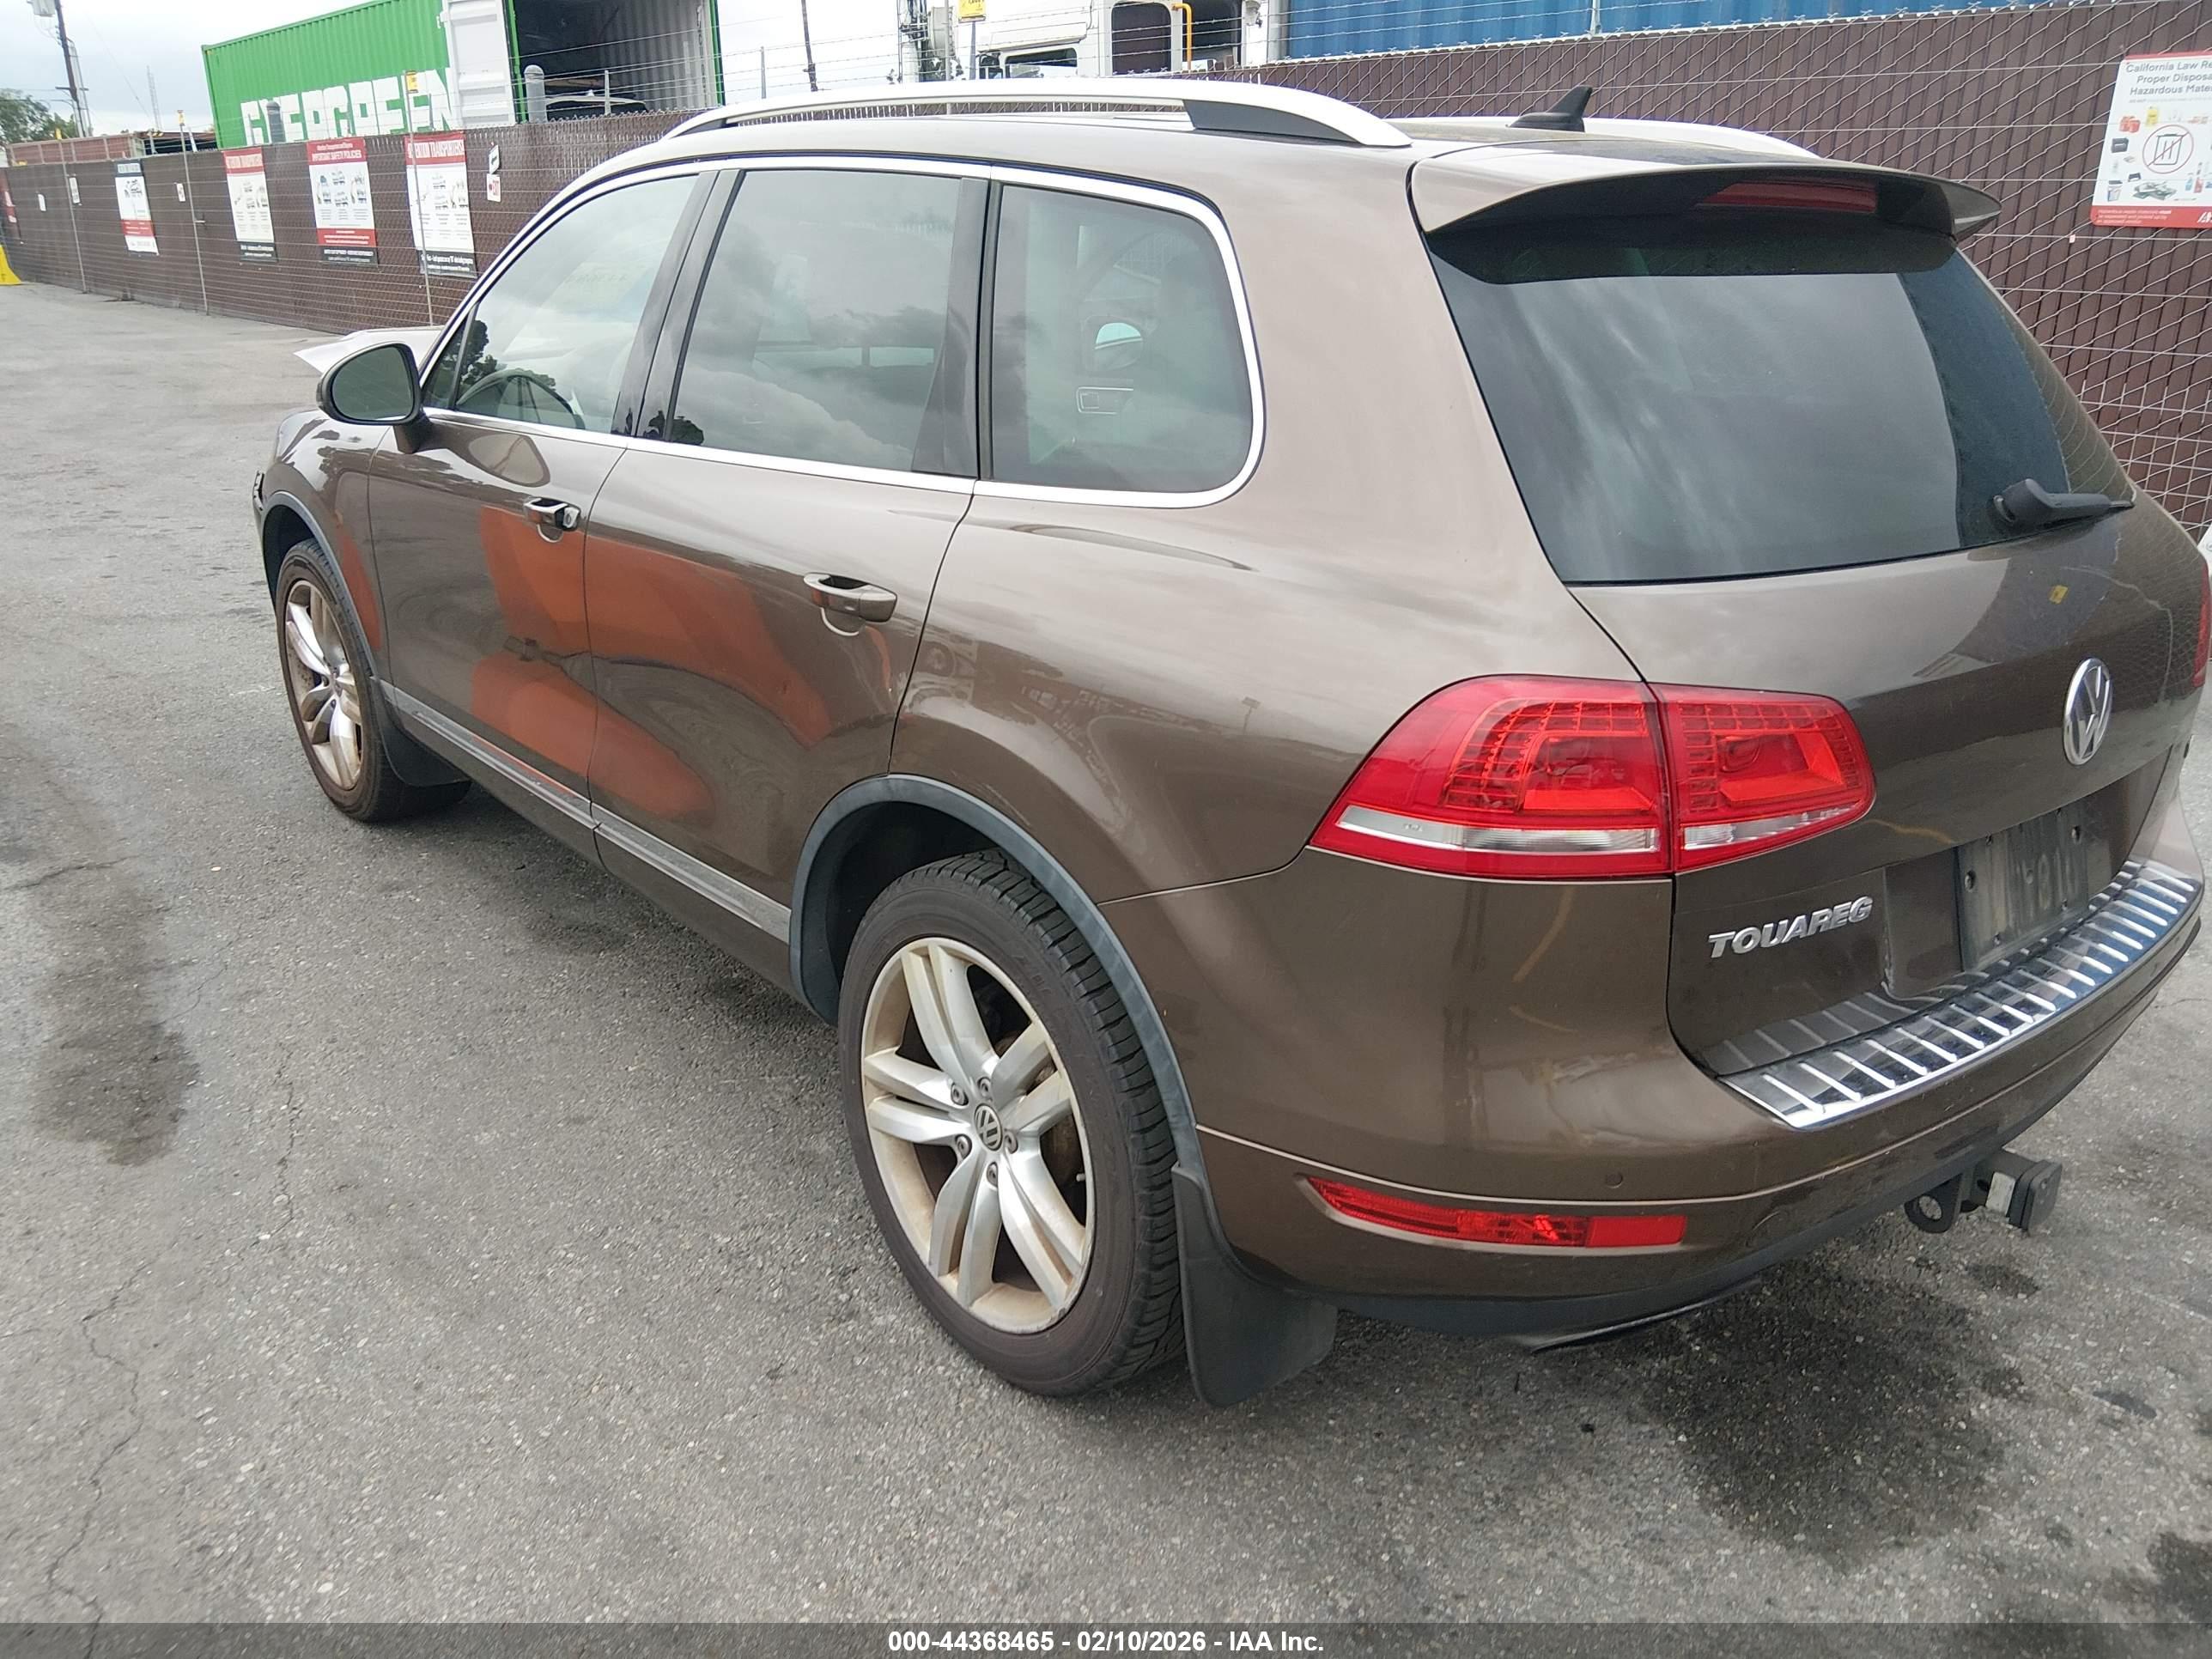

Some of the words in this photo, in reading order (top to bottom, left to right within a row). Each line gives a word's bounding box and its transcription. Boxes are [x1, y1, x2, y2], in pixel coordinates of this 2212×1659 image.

[2126, 61, 2174, 73] California
[2177, 62, 2198, 70] Law
[2136, 75, 2171, 84] Proper
[2130, 86, 2184, 95] Hazardous
[1708, 896, 1874, 958] TOUAREG
